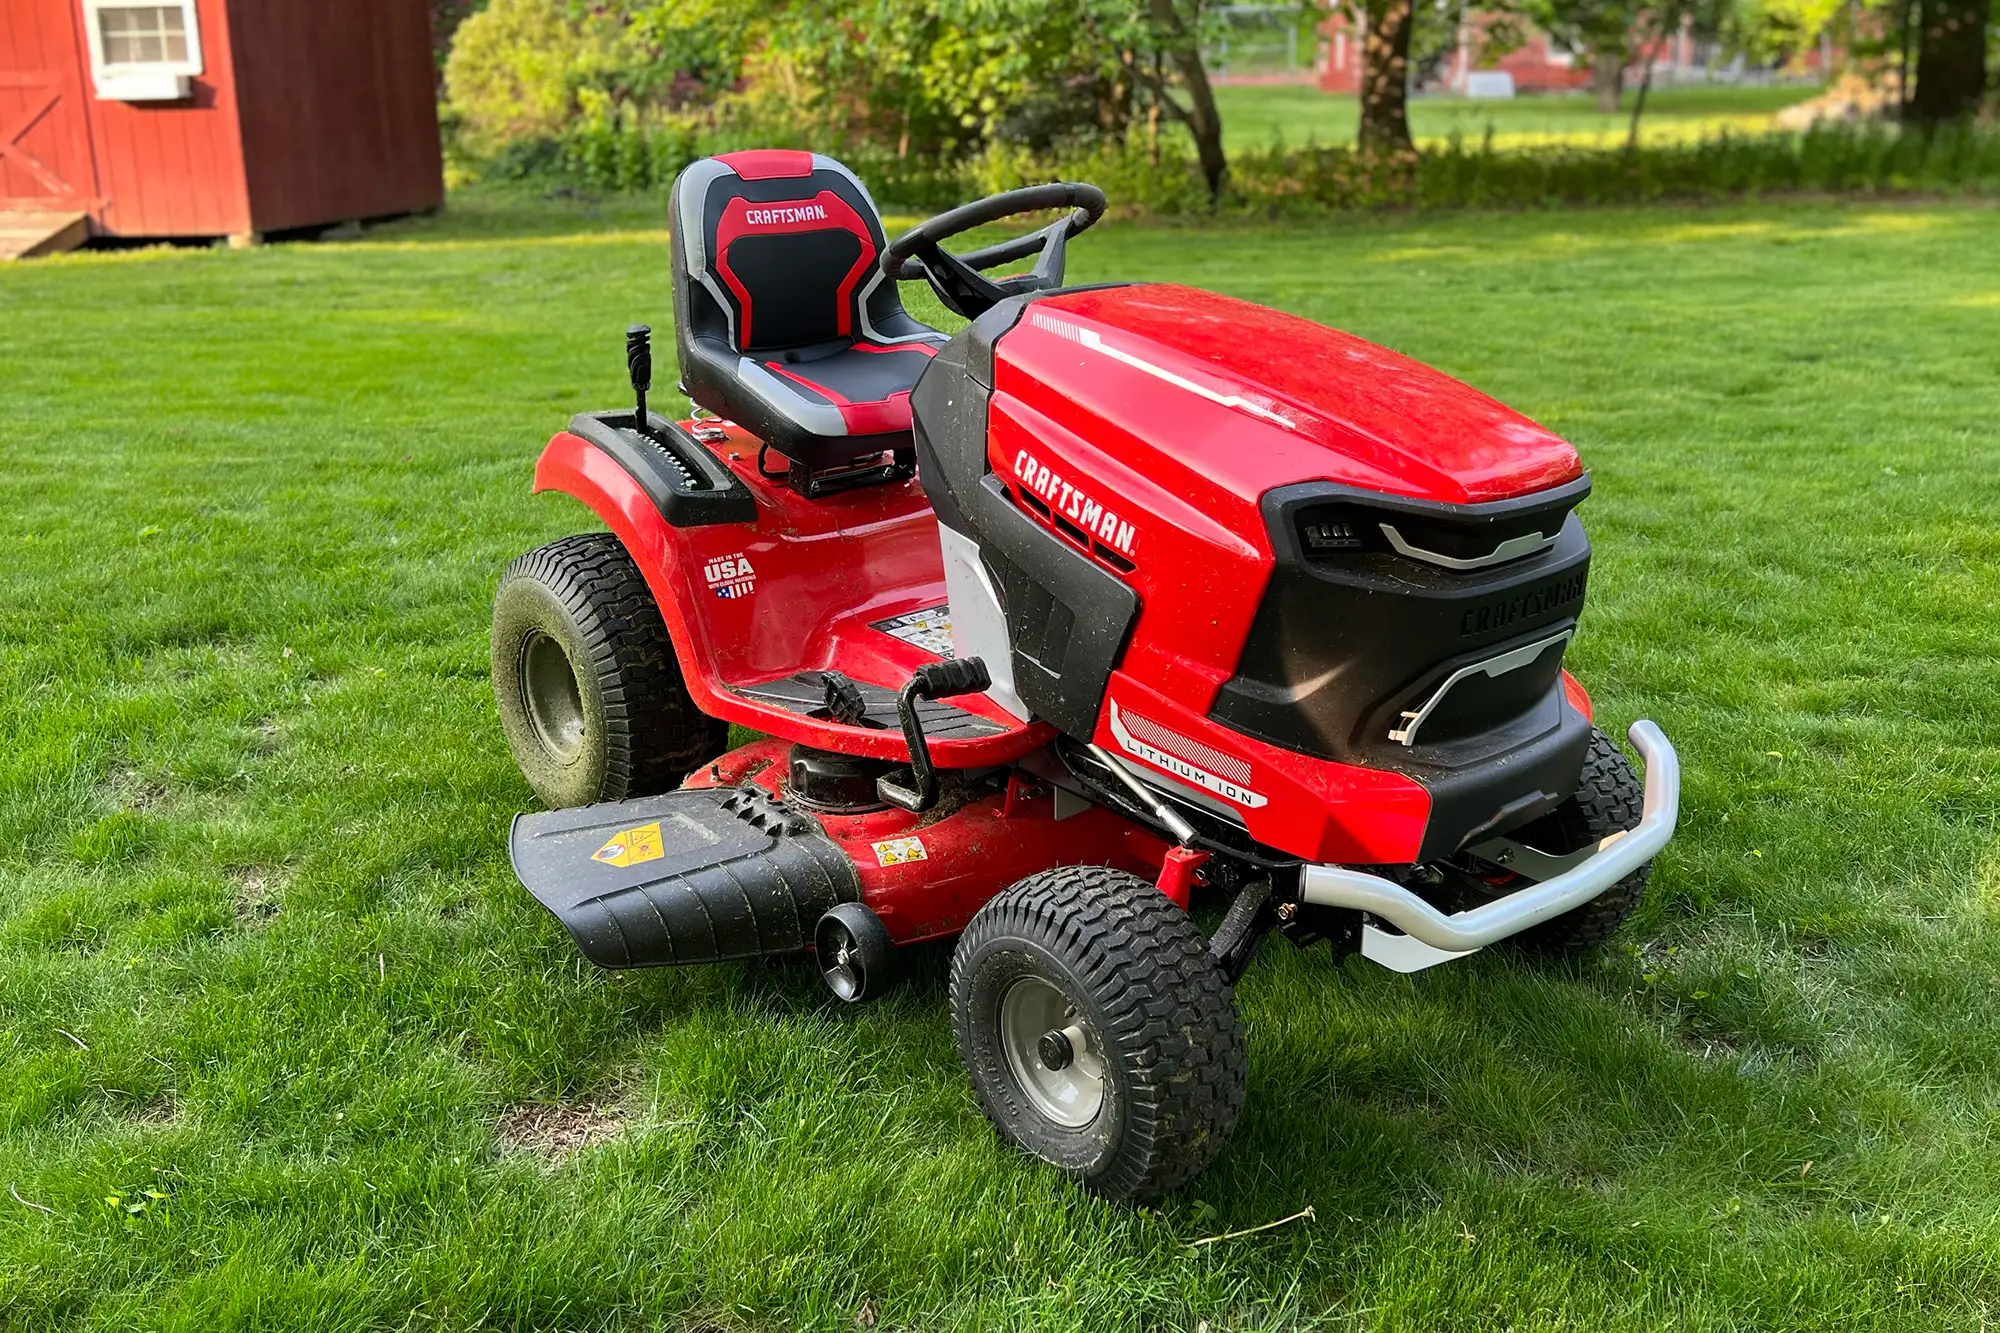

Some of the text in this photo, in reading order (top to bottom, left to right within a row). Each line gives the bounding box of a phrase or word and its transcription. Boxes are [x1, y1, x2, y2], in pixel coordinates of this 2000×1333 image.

[746, 205, 825, 225] CRAFTSMAN
[1014, 449, 1136, 554] CRAFTSMAN
[704, 558, 754, 582] USA
[708, 556, 725, 564] MADE
[1460, 571, 1584, 638] CRAFTSMAN
[1127, 739, 1252, 805] LITHIUM ION
